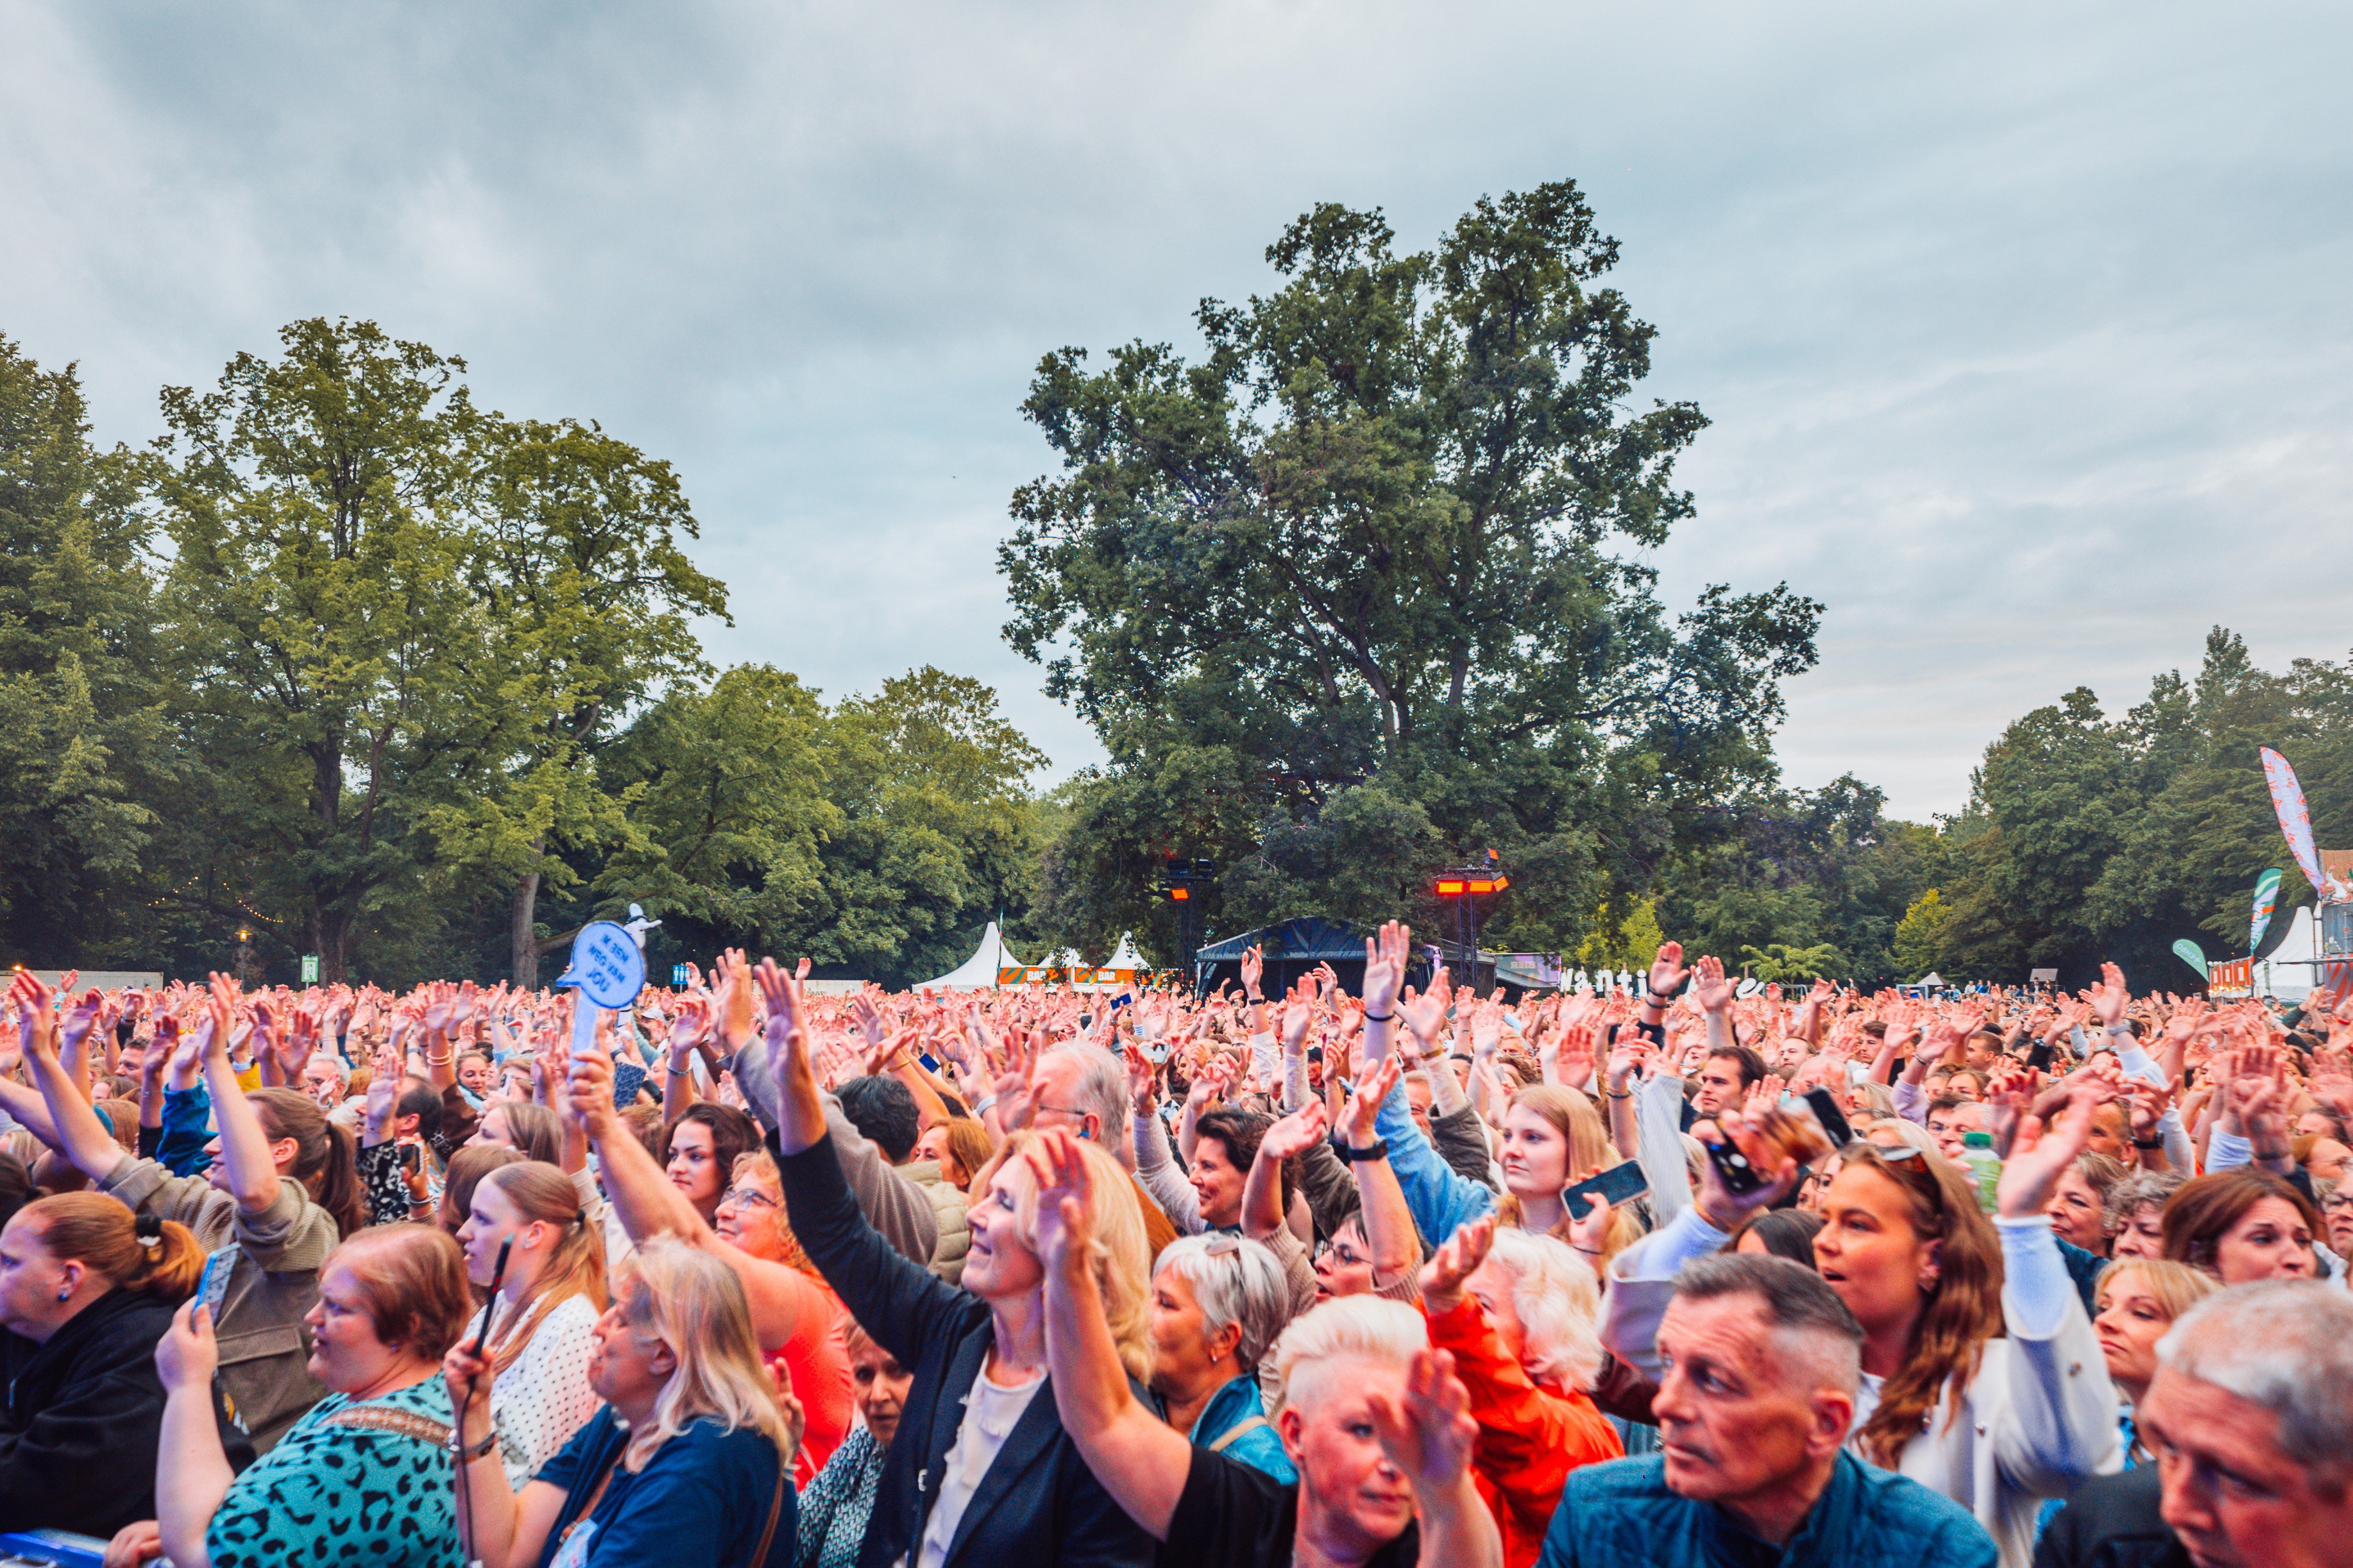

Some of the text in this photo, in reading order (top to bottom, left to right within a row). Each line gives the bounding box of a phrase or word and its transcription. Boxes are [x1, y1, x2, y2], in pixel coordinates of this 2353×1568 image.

[609, 943, 629, 963] BEN
[588, 945, 625, 982] WEG VAN
[586, 969, 610, 992] JOU
[1027, 970, 1046, 981] BAR
[1098, 971, 1115, 981] BAR
